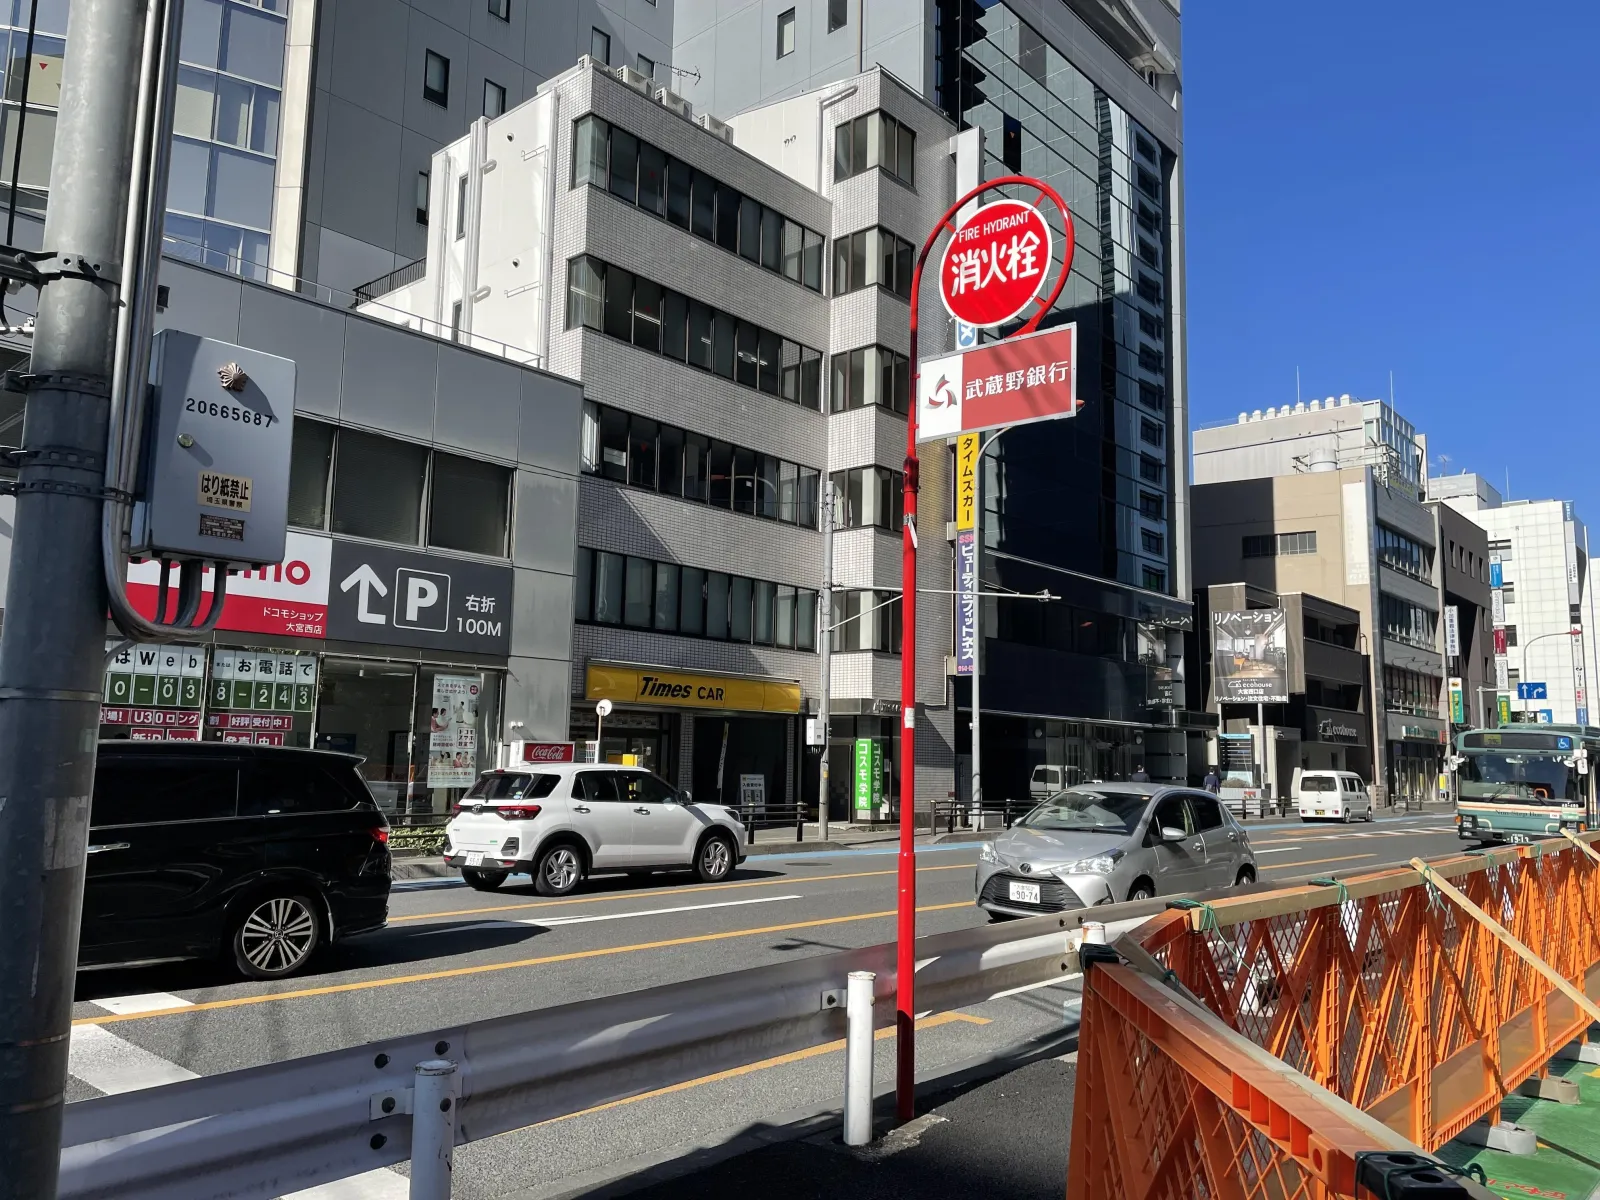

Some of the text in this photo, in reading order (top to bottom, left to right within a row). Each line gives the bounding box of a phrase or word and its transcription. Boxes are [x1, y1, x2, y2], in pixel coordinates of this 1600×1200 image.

[958, 210, 1030, 244] FIRE HYDRANT
[951, 230, 1041, 297] 消火栓
[965, 360, 1069, 401] 武蔵野銀行
[186, 397, 274, 428] 20665687
[201, 474, 249, 501] はり紙禁止
[962, 437, 974, 522] タイムズカー
[263, 606, 324, 622] ドコモショップ
[405, 577, 439, 622] P
[465, 594, 496, 614] 右折
[285, 623, 323, 635] 大宮西店
[457, 617, 502, 637] 100M
[1214, 611, 1283, 625] リノベーション
[640, 677, 724, 701] Times CAR
[858, 743, 881, 808] コスモ学院 コスモ学院
